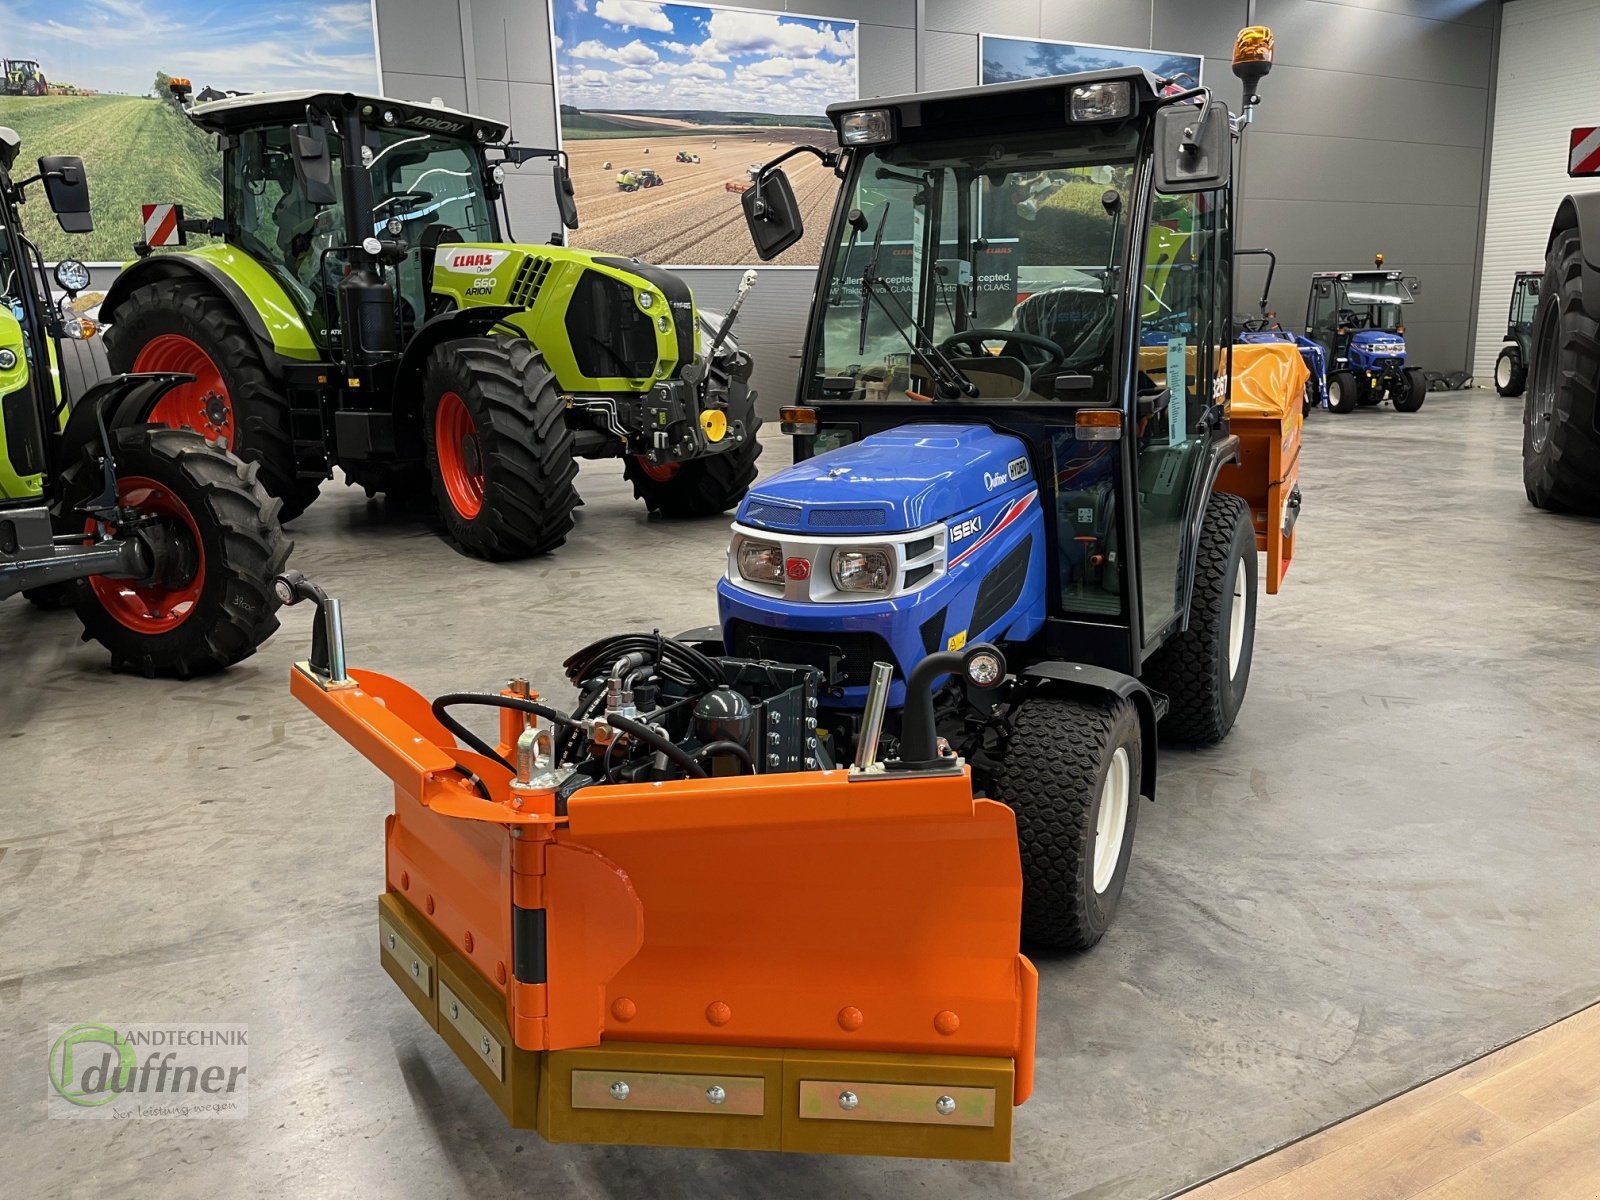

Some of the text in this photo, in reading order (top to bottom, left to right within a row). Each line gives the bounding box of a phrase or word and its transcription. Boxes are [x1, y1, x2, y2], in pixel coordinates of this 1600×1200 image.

[405, 115, 464, 132] ARION
[453, 254, 493, 267] CLAAS
[473, 277, 497, 288] 660
[464, 287, 493, 297] ARION
[1009, 459, 1028, 479] HYDRO
[949, 515, 982, 544] ISEKI
